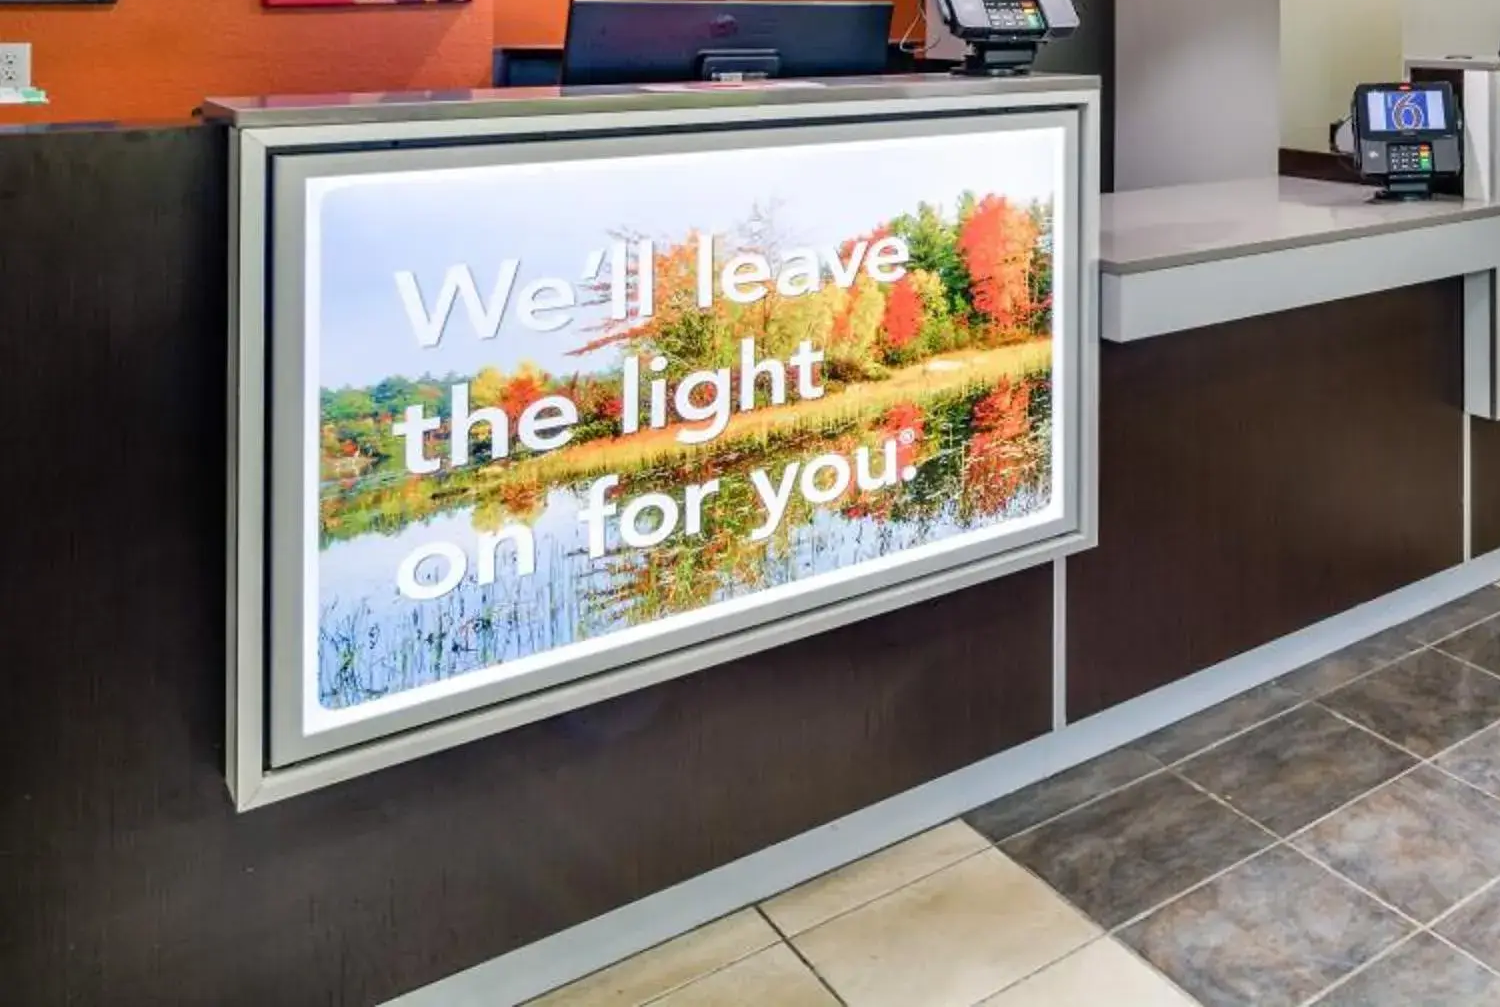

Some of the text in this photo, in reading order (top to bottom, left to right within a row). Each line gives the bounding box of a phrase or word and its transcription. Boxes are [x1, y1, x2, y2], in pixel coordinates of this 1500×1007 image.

[696, 233, 911, 310] leave
[391, 337, 826, 475] the light
[396, 520, 537, 600] on
[577, 473, 720, 559] for
